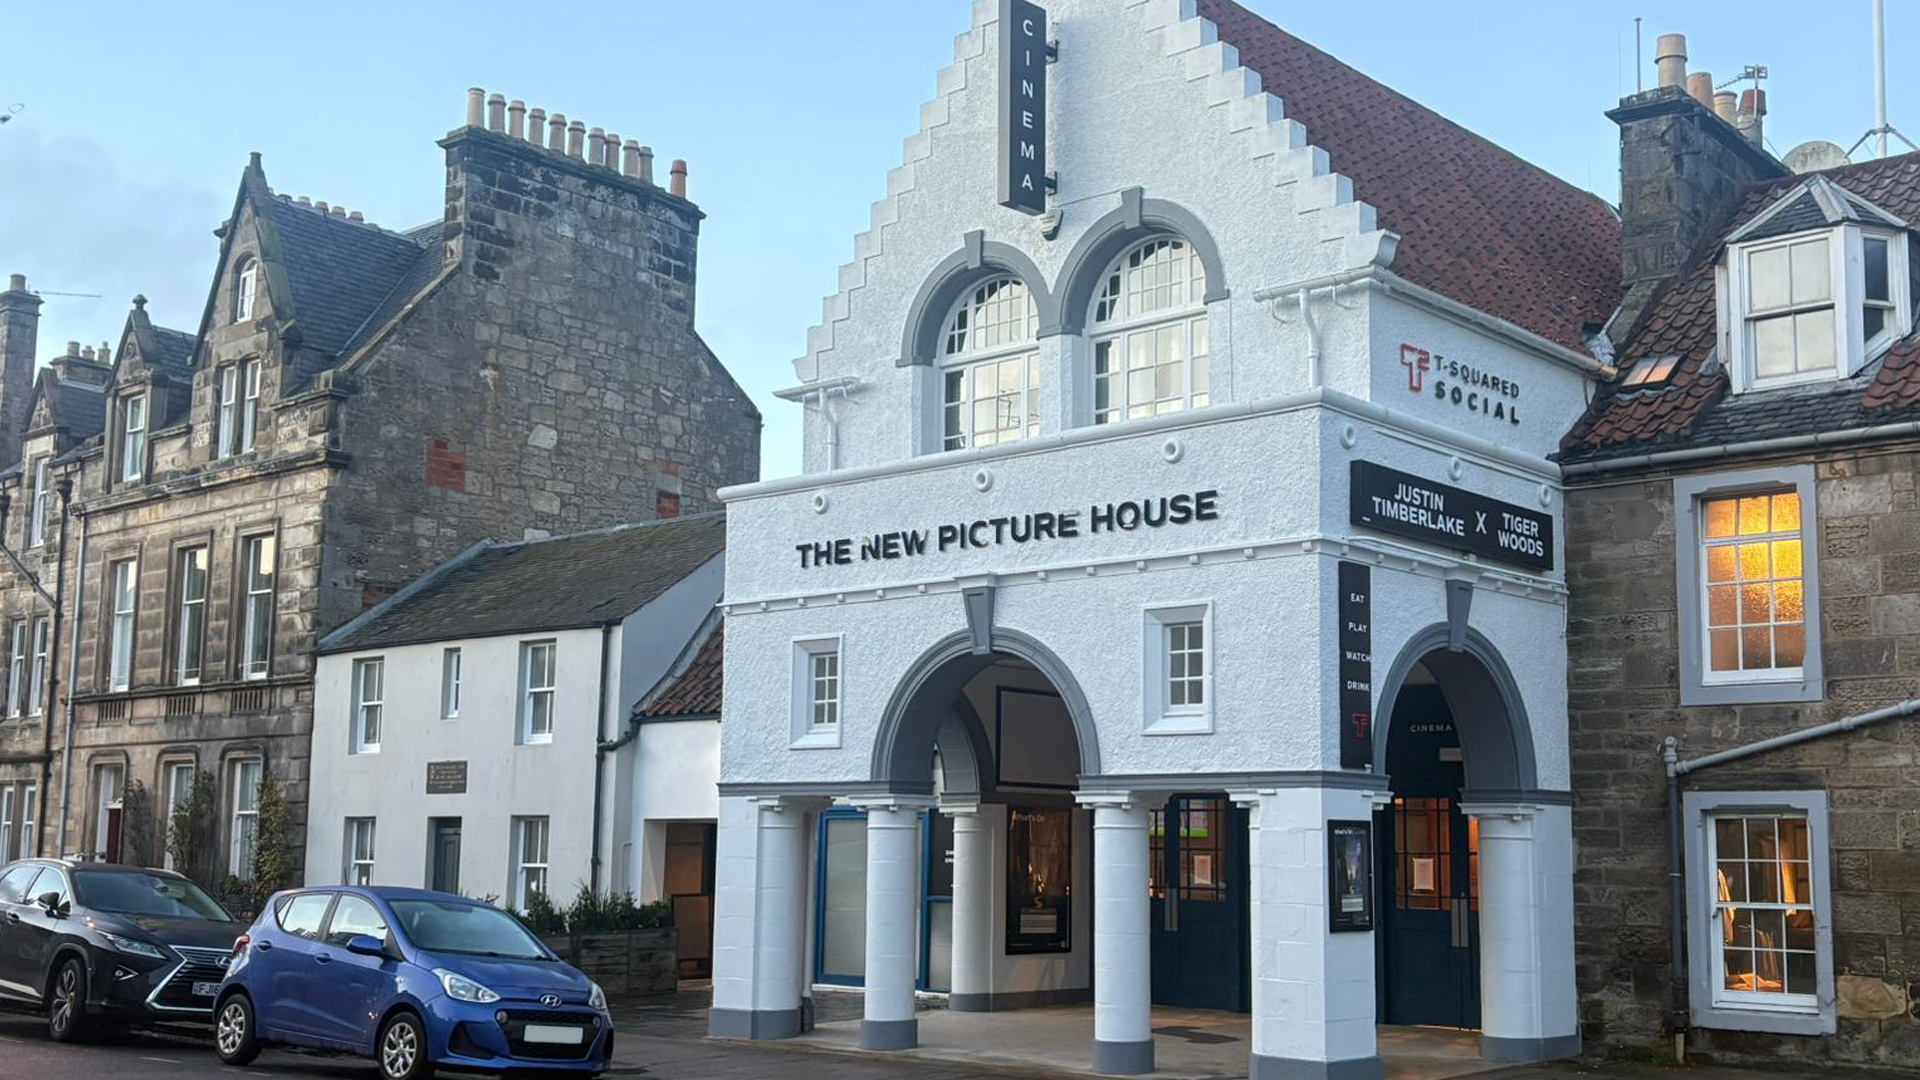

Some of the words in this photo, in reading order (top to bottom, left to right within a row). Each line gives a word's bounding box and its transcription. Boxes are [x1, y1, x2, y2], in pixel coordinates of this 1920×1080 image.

[1021, 19, 1035, 191] CINEMA
[1434, 354, 1520, 399] T-SQUARED
[1435, 381, 1520, 425] SOCIAL
[1394, 483, 1445, 512] JUSTIN
[796, 538, 852, 568] THE
[861, 529, 929, 561] NEW
[938, 509, 1080, 551] PICTURE
[1090, 490, 1219, 533] HOUSE
[1372, 496, 1465, 537] TIMBERLAKE
[1475, 511, 1488, 535] X
[1502, 512, 1539, 538] TIGER
[1498, 530, 1544, 558] WOODS
[1350, 592, 1365, 604] EAT
[1348, 622, 1368, 634] PLAY
[1346, 651, 1372, 663] WATCH
[1347, 680, 1370, 692] DRINK
[1410, 724, 1453, 733] CINEMA
